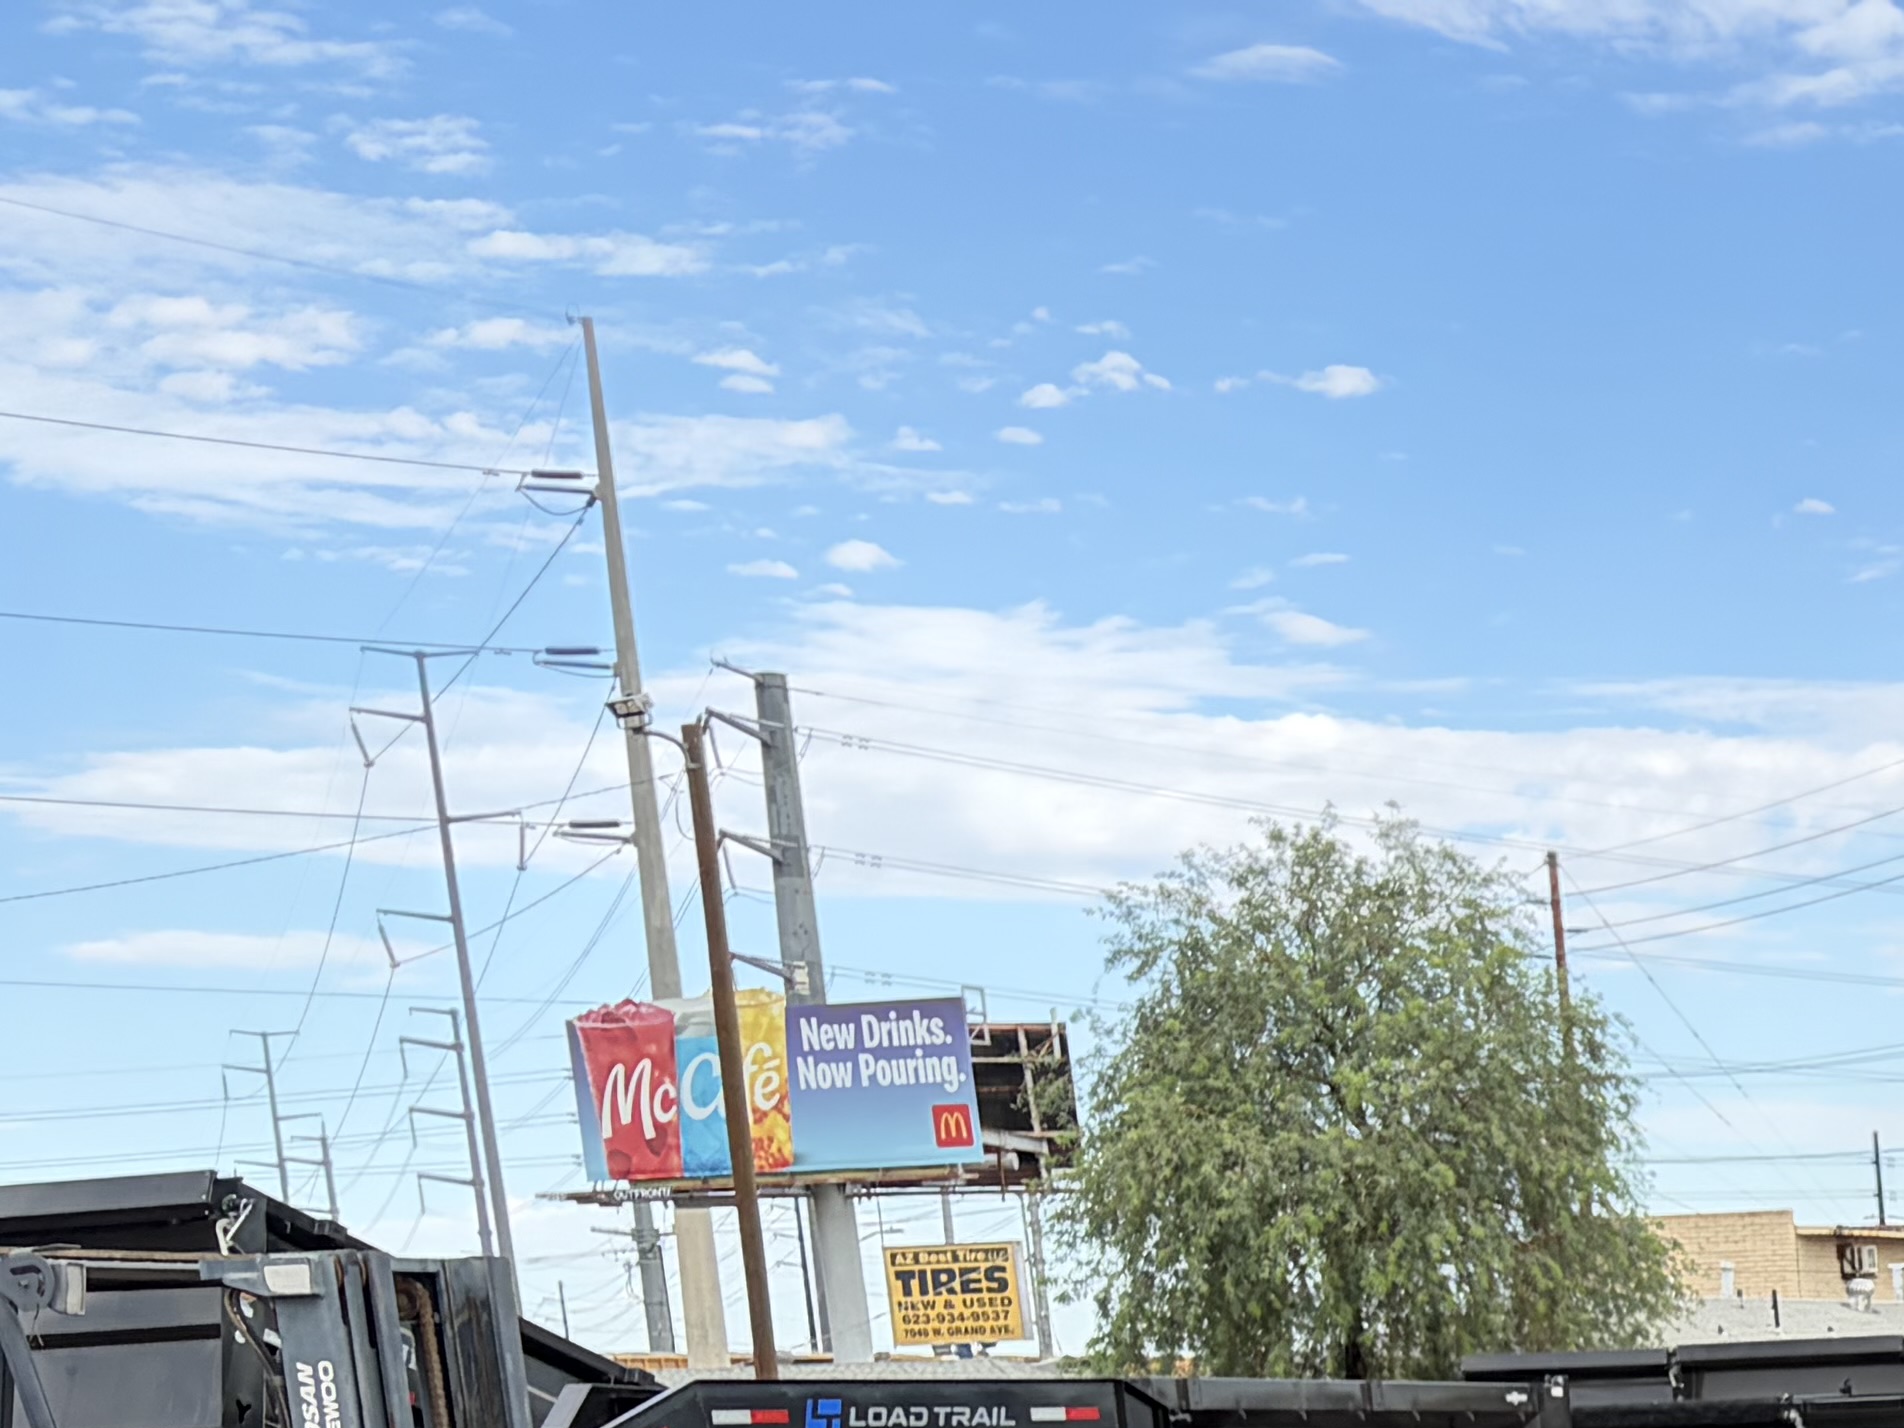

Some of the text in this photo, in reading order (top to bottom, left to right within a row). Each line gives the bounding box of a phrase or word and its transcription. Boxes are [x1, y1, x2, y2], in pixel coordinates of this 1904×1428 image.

[799, 1009, 953, 1052] New Drinks.
[796, 1047, 967, 1093] Now Pouring.
[602, 1041, 782, 1140] McCfé
[894, 1264, 1010, 1297] TIRES
[897, 1296, 1013, 1312] NEW & USED
[946, 1325, 987, 1337] GRAND
[848, 1405, 1017, 1428] LOAD TRAIL
